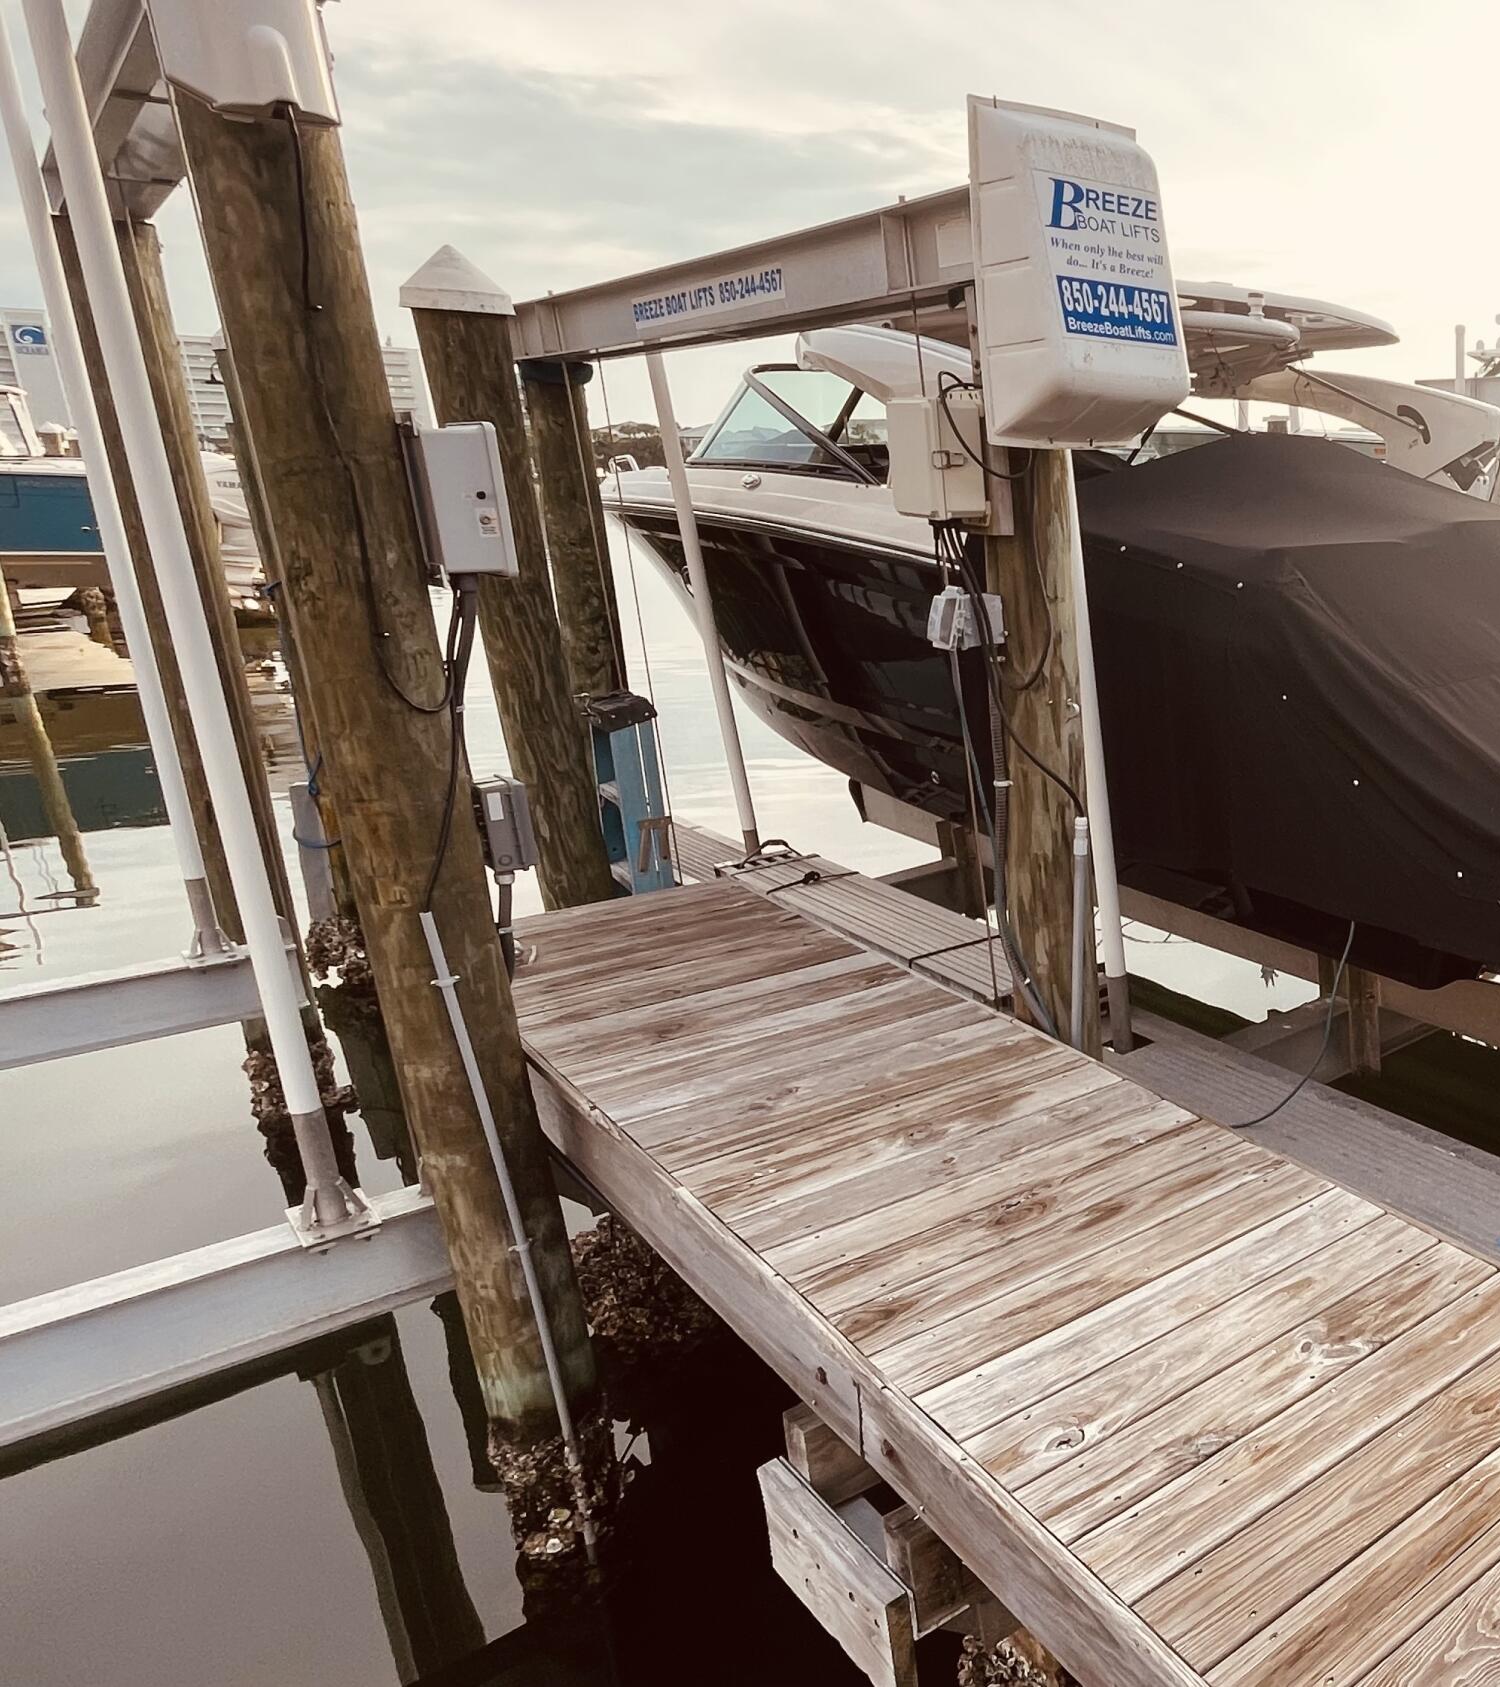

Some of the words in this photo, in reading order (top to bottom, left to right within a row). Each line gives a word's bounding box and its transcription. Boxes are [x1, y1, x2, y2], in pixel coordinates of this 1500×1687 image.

[1045, 177, 1158, 231] BREEZE
[1076, 213, 1117, 235] BOAT
[1120, 222, 1161, 243] LIFTS
[1050, 236, 1081, 251] When
[1083, 244, 1106, 257] only
[1107, 246, 1124, 258] the
[1126, 249, 1145, 262] best
[1146, 255, 1164, 266] will
[1066, 255, 1088, 268] do...
[1091, 259, 1107, 270] It's
[1110, 264, 1116, 273] a
[1119, 263, 1154, 279] Breeze!
[633, 298, 665, 322] BREEZE
[665, 292, 687, 316] BOAT
[688, 285, 715, 310] LIFTS
[718, 268, 782, 304] 850-244-4567
[1061, 279, 1169, 325] 850-244-4567
[1067, 316, 1175, 343] BreezeBoatLifts.com
